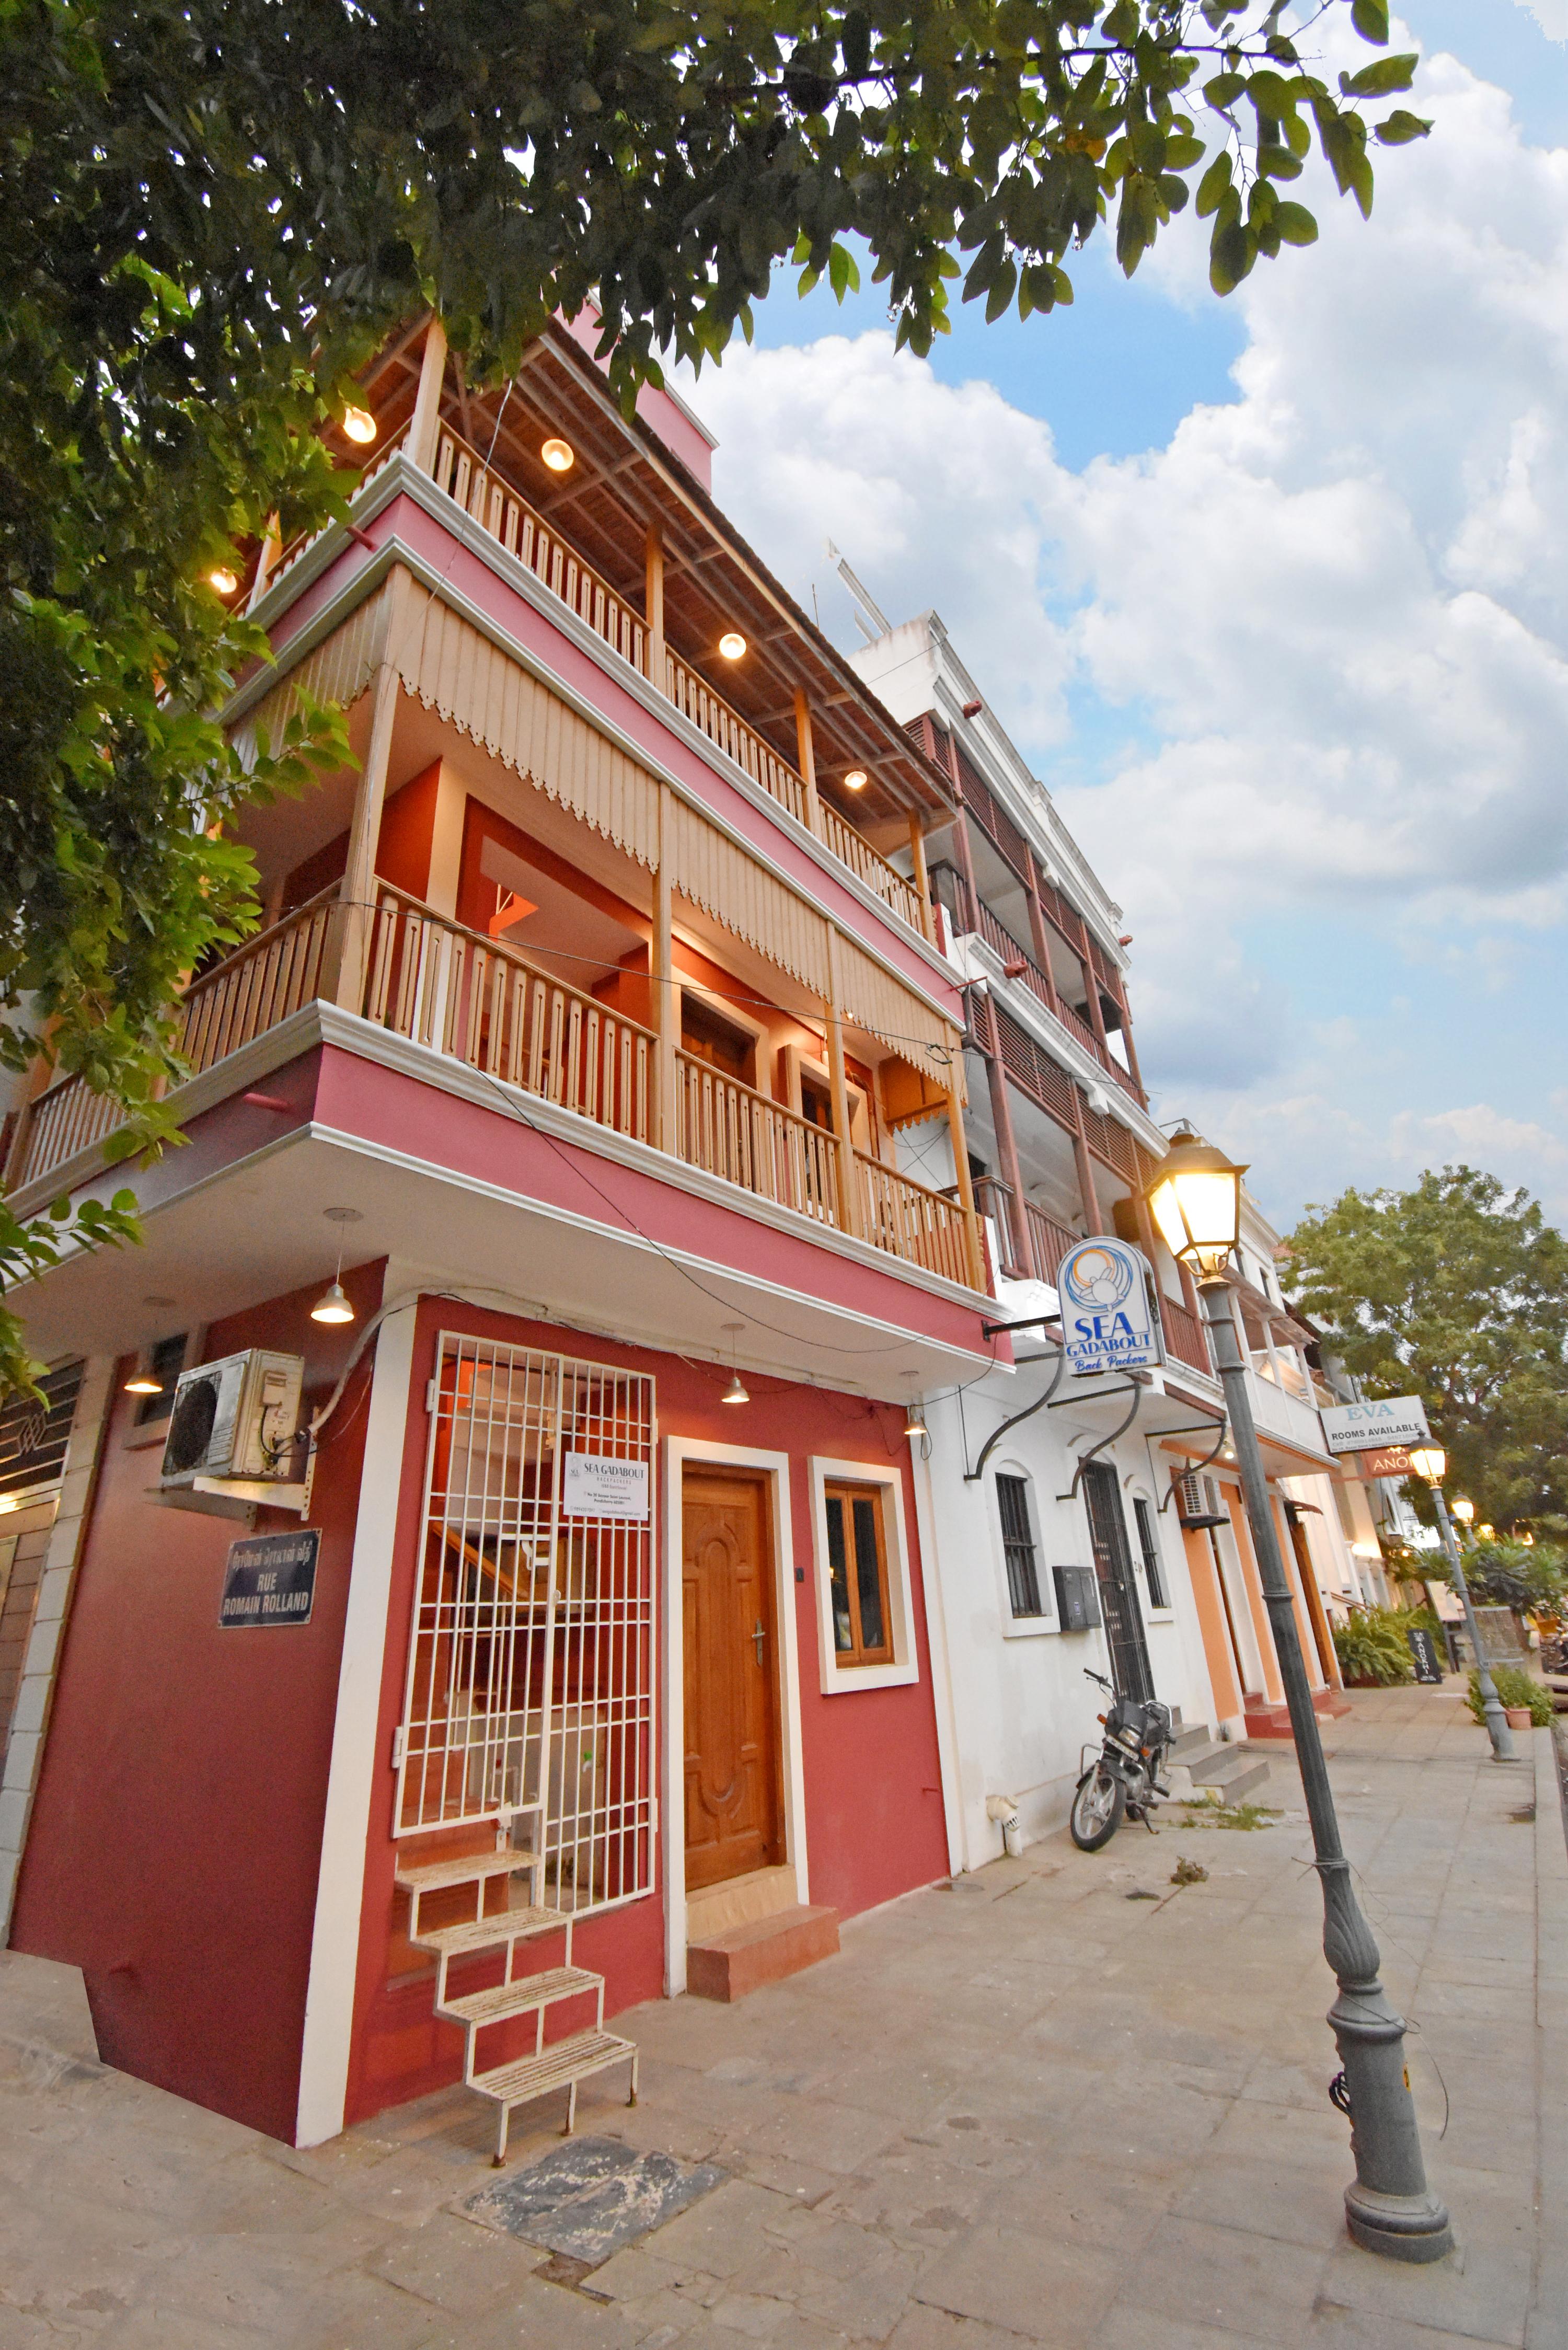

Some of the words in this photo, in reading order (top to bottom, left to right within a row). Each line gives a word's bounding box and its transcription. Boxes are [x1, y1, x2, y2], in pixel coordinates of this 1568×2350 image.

[1075, 1312, 1134, 1342] SEA
[1066, 1333, 1150, 1356] GADABOUT
[1075, 1358, 1102, 1372] Back
[1106, 1354, 1147, 1367] Packers
[1345, 1403, 1395, 1421] EVA
[1331, 1430, 1365, 1441] ROOMS
[1368, 1423, 1421, 1436] AVAILABLE
[585, 1463, 599, 1473] SEA
[601, 1465, 644, 1479] GADABOUT
[257, 1572, 278, 1592] RUE
[223, 1596, 260, 1616] ROMAIN
[262, 1592, 309, 1613] ROLLAND
